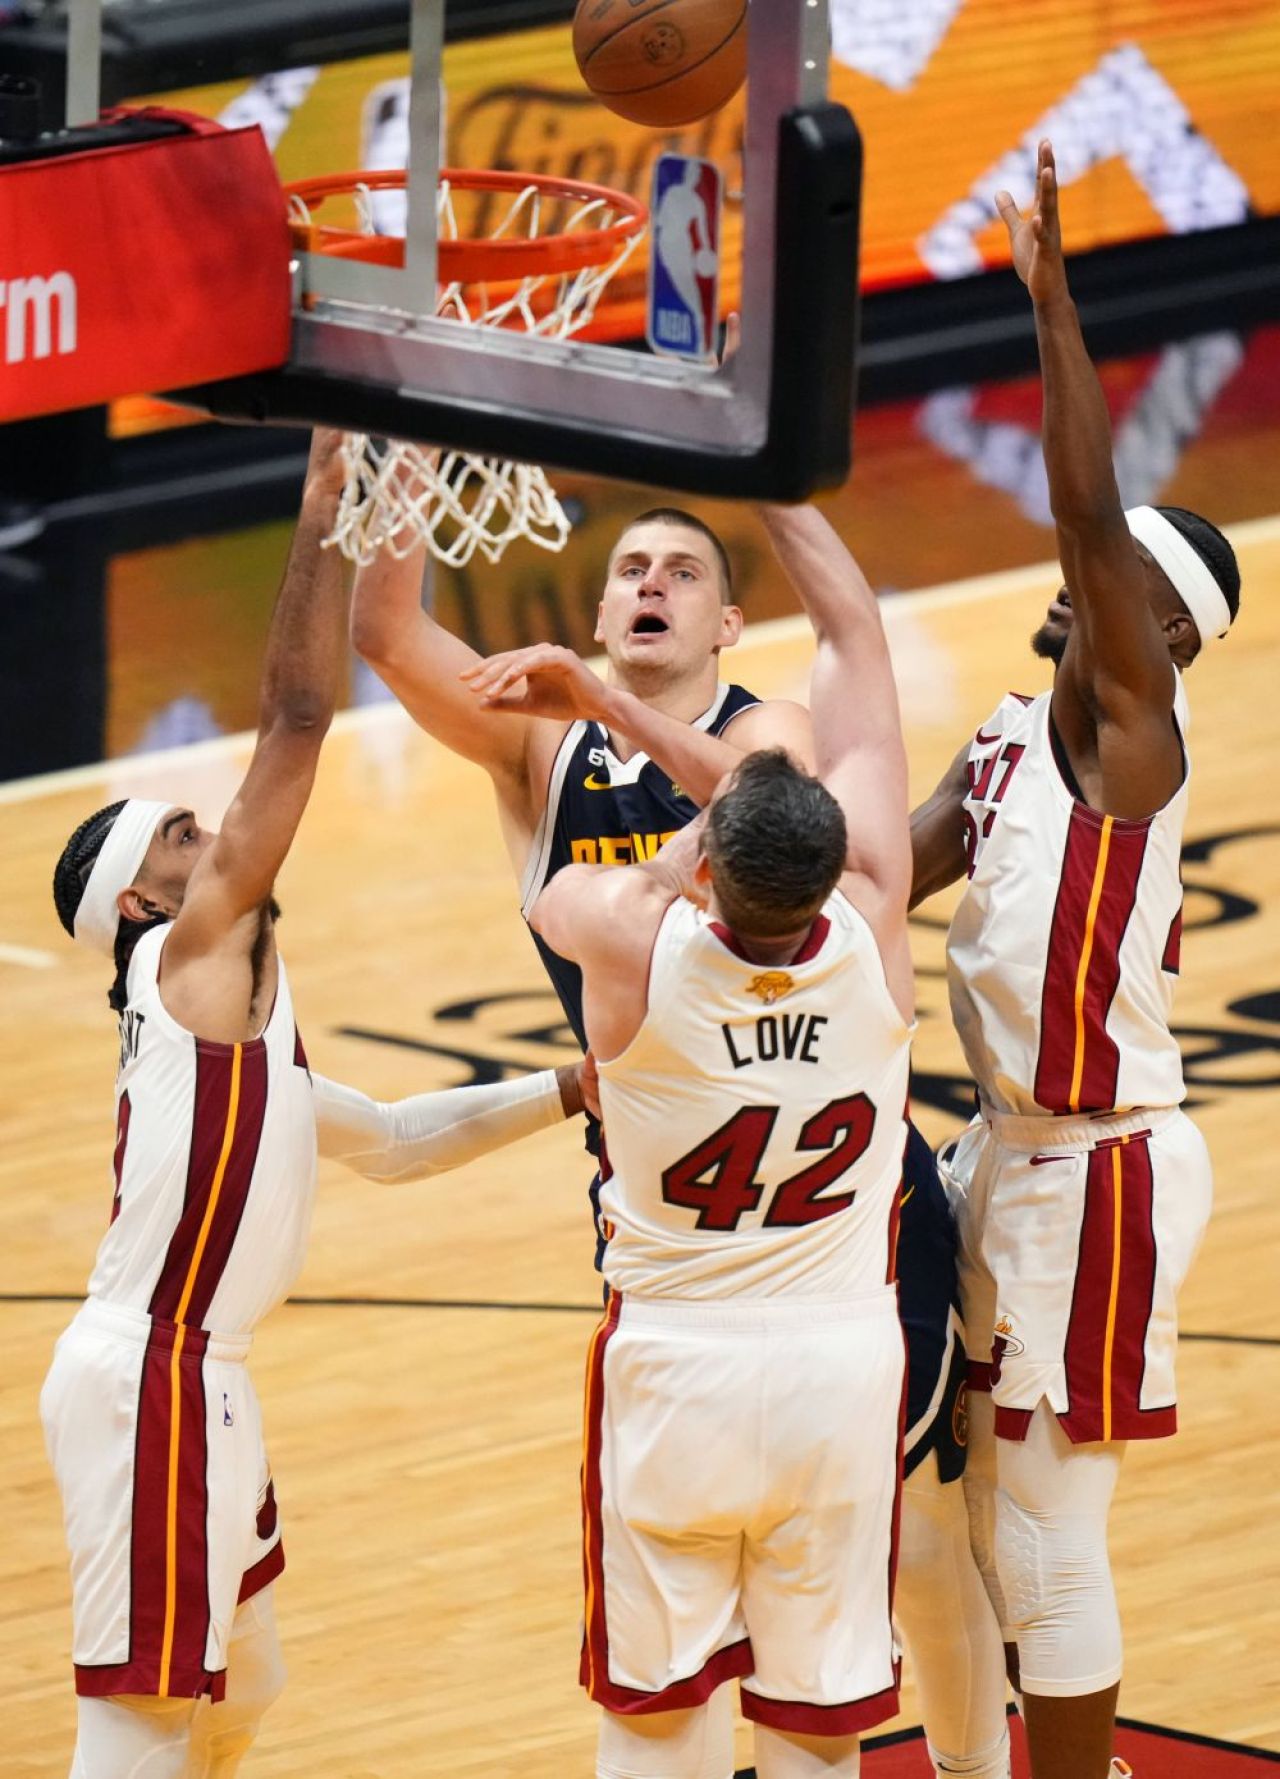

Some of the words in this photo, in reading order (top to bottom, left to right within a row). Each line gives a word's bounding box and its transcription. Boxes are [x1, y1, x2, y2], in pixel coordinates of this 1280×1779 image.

[656, 307, 692, 345] NBA
[721, 1013, 829, 1069] LOVE
[661, 1091, 877, 1231] 42
